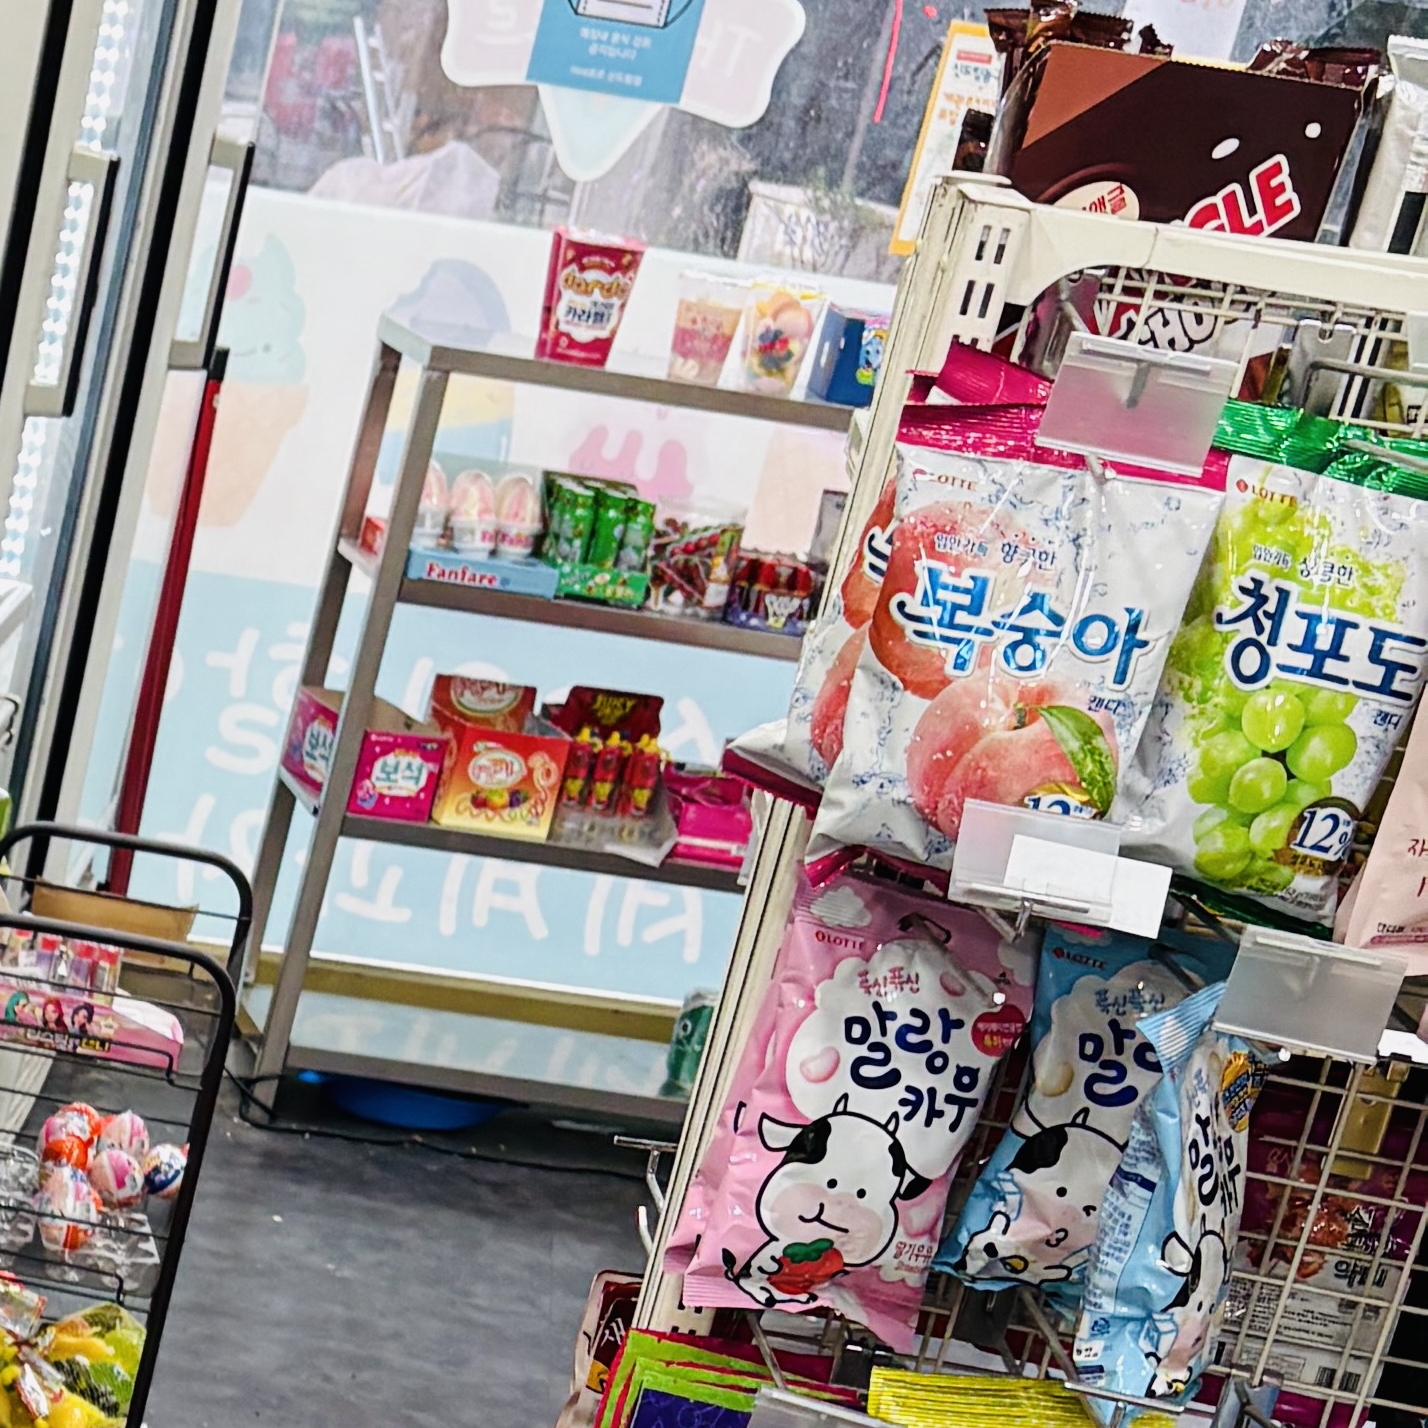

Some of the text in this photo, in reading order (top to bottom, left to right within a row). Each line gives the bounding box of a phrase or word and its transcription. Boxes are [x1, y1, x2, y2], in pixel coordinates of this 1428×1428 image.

[425, 561, 499, 589] Fanfare
[890, 567, 1148, 687] 복숭아
[1217, 576, 1428, 699] 청포도
[376, 758, 425, 787] 보석
[845, 1001, 965, 1089] 말랑
[1078, 1018, 1163, 1108] 말
[900, 1064, 979, 1134] 카우
